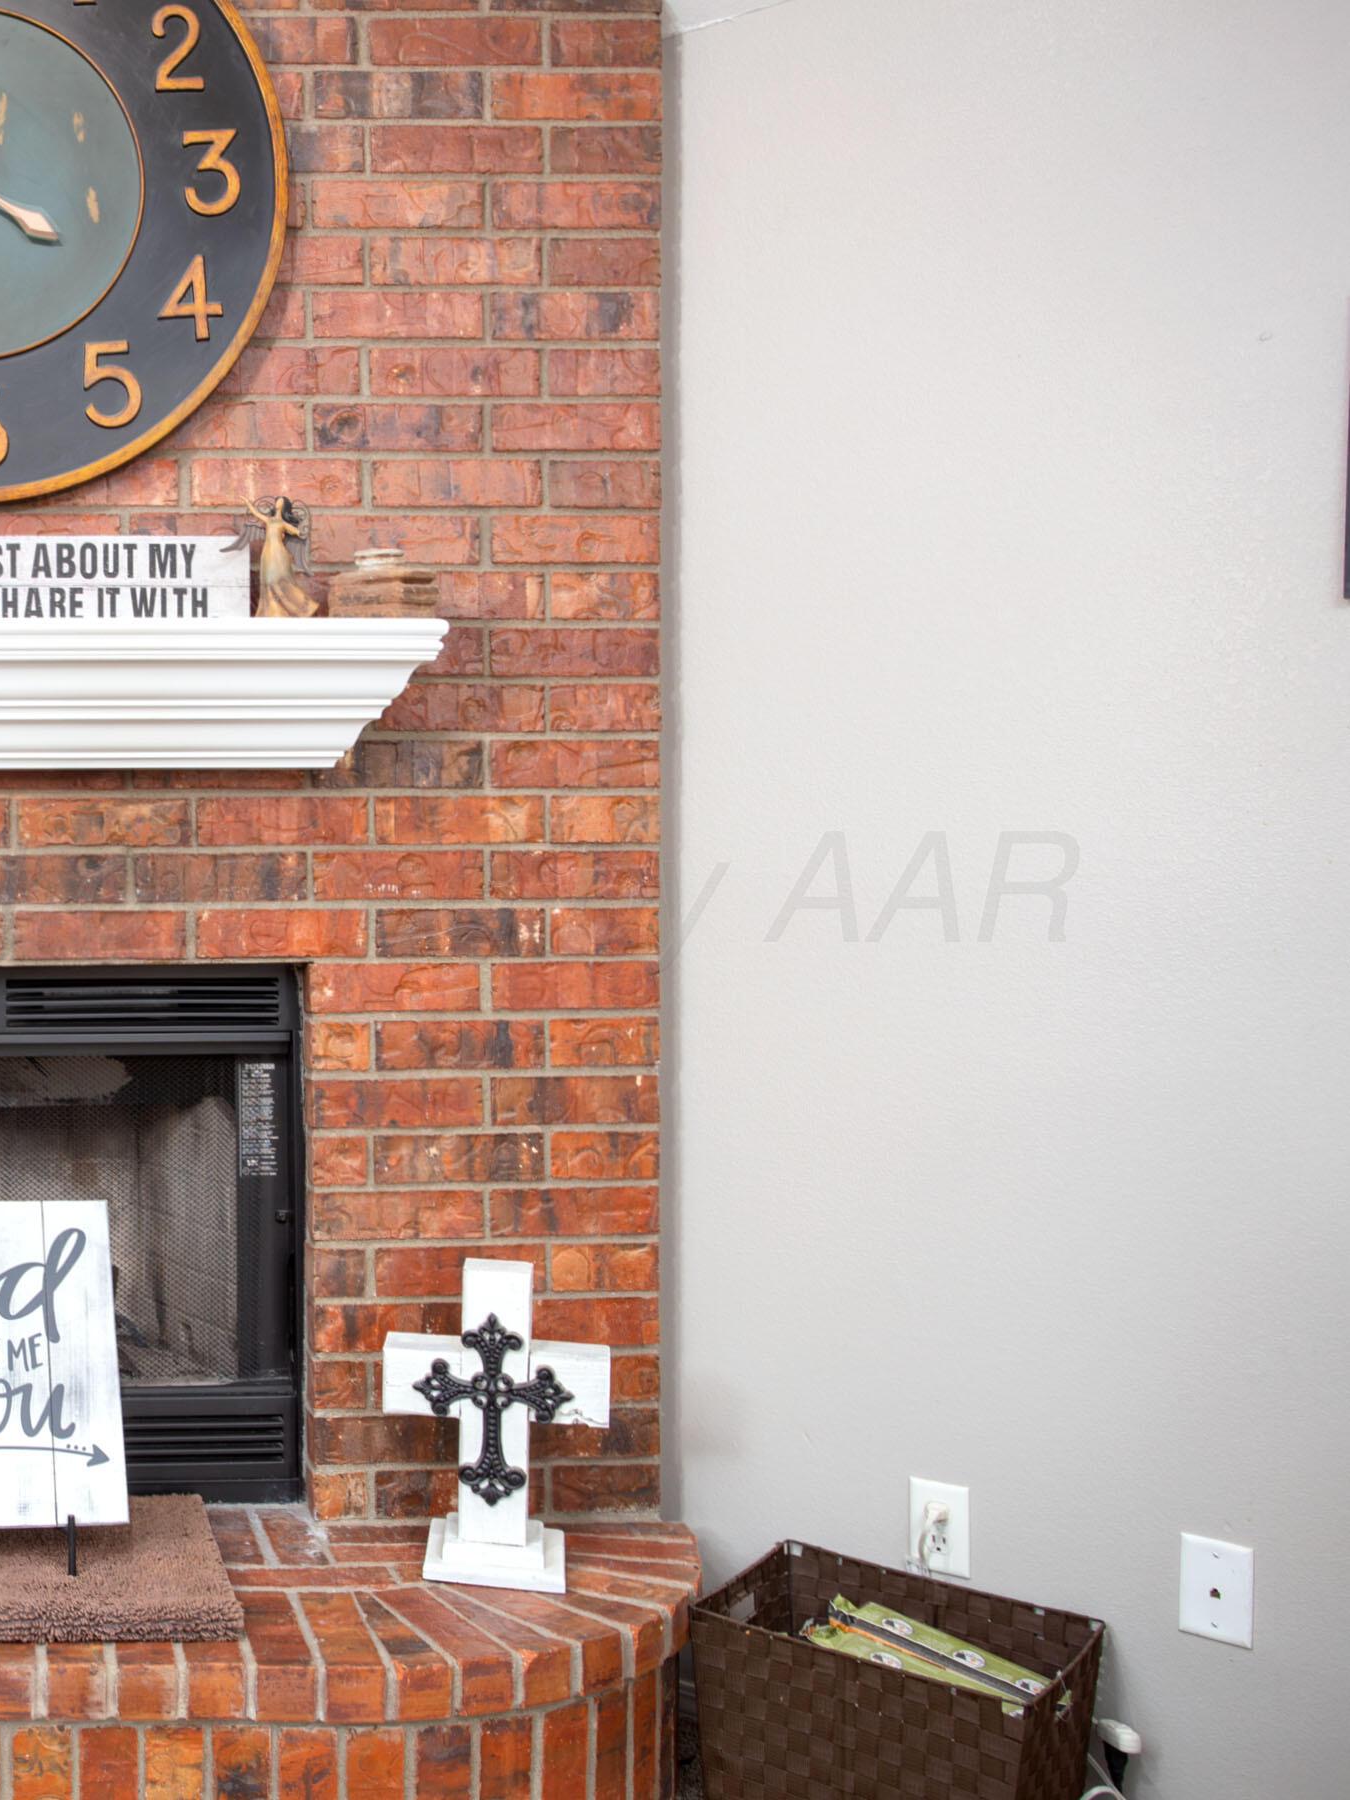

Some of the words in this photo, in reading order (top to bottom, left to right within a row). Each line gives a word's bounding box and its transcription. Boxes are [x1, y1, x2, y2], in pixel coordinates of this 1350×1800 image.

[151, 5, 205, 91] 2
[182, 128, 241, 216] 3
[158, 254, 223, 341] 4
[83, 340, 143, 429] 5
[31, 542, 138, 580] ABOUT
[148, 543, 196, 580] MY
[97, 586, 121, 618] IT
[130, 586, 208, 618] WITH
[7, 1332, 43, 1372] ME
